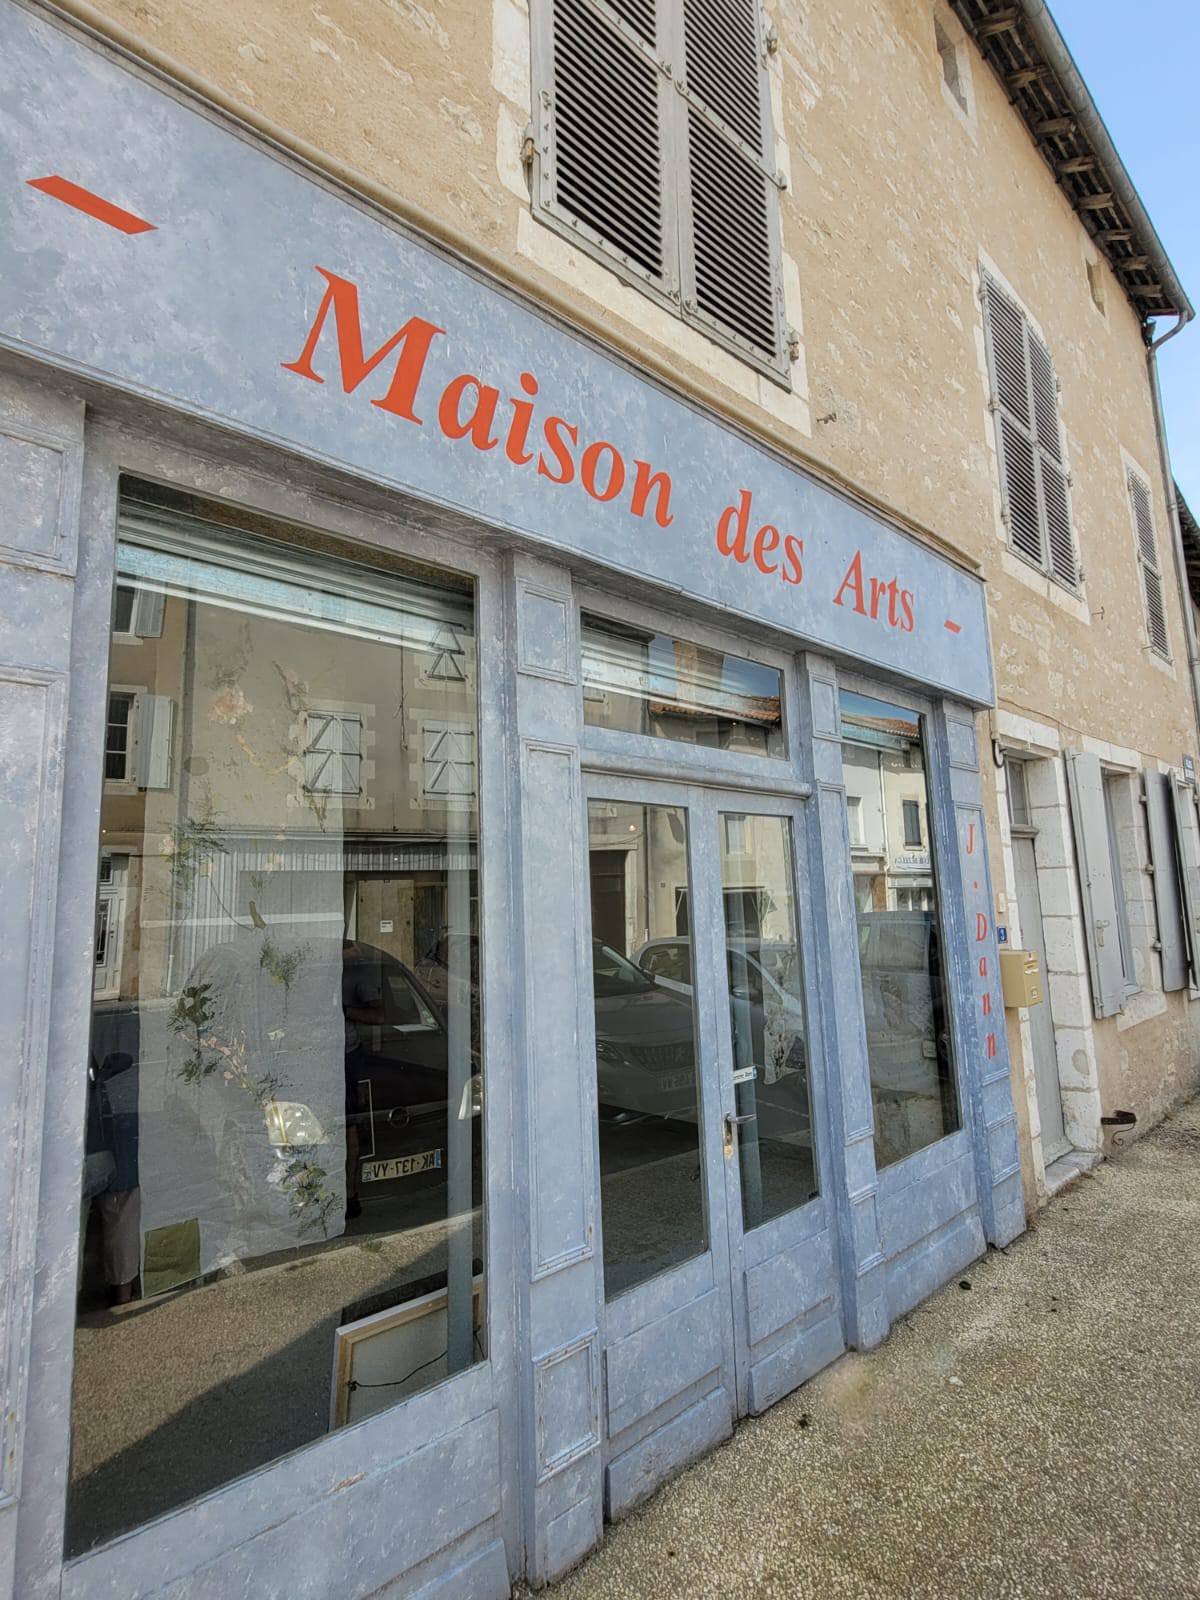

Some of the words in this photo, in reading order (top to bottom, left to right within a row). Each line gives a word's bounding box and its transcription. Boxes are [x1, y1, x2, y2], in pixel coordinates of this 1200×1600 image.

[281, 265, 673, 528] Maison
[716, 489, 804, 585] des
[832, 550, 915, 632] Arts
